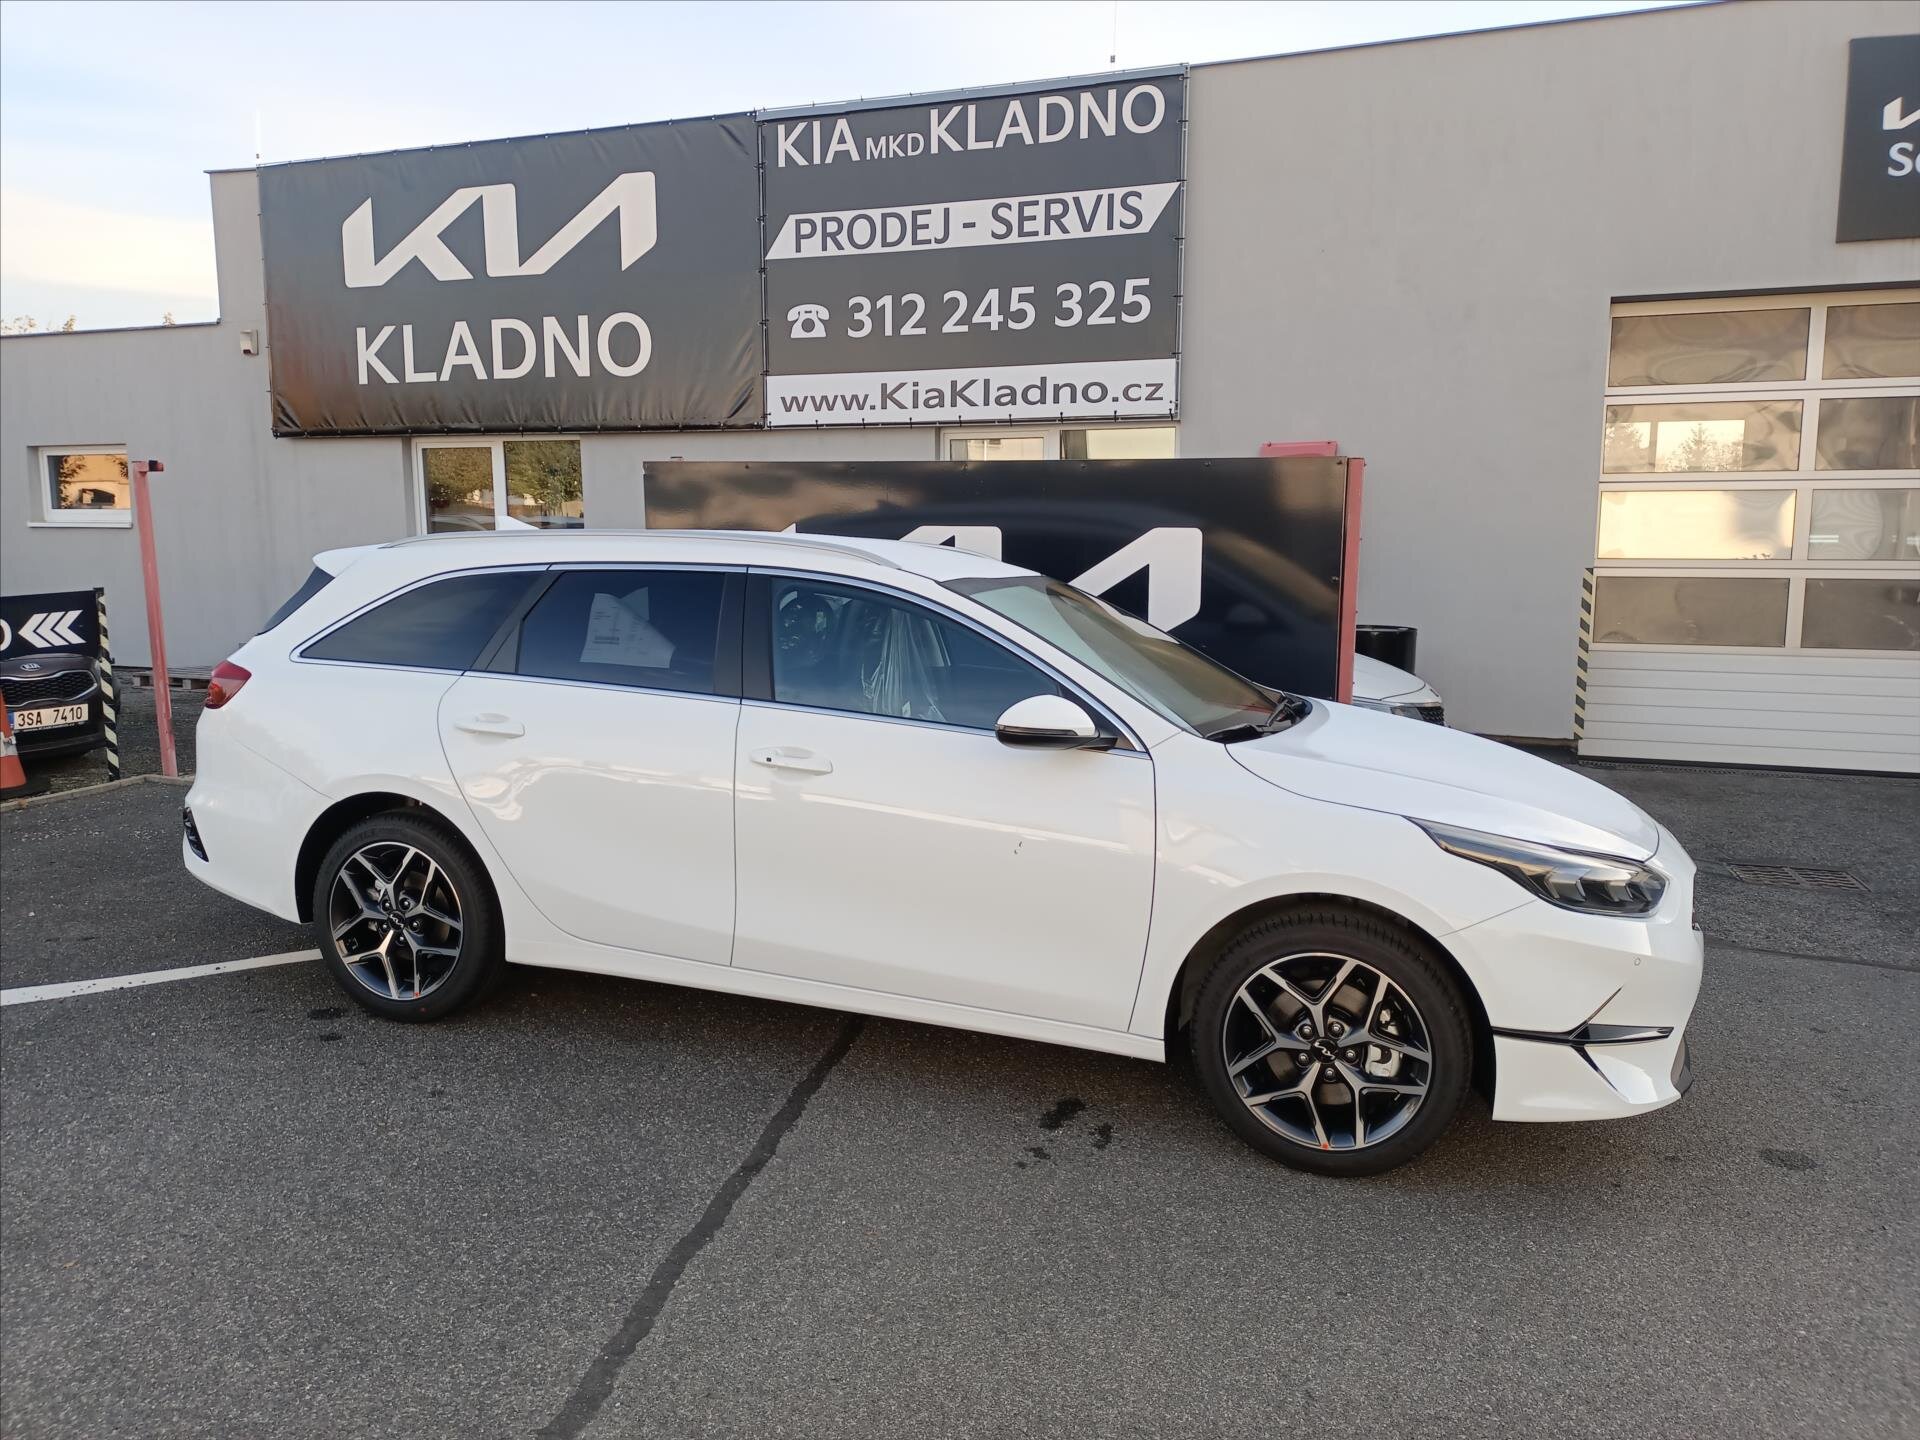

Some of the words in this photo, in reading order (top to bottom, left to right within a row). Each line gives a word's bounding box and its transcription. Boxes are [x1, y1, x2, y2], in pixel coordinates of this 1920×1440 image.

[777, 118, 861, 168] KIA
[866, 132, 925, 161] MKD
[930, 84, 1166, 154] KLADNO
[1888, 142, 1920, 177] S
[341, 171, 658, 289] KIA
[794, 206, 951, 253] PRODEJ
[990, 190, 1143, 240] SERVIS
[847, 292, 927, 339] 312
[941, 285, 1036, 334] 245
[1054, 277, 1151, 326] 325
[355, 311, 653, 385] KLADNO
[780, 376, 1165, 413] www.KiaKladno.cz
[18, 711, 43, 727] 3SA
[53, 706, 83, 723] 7410
